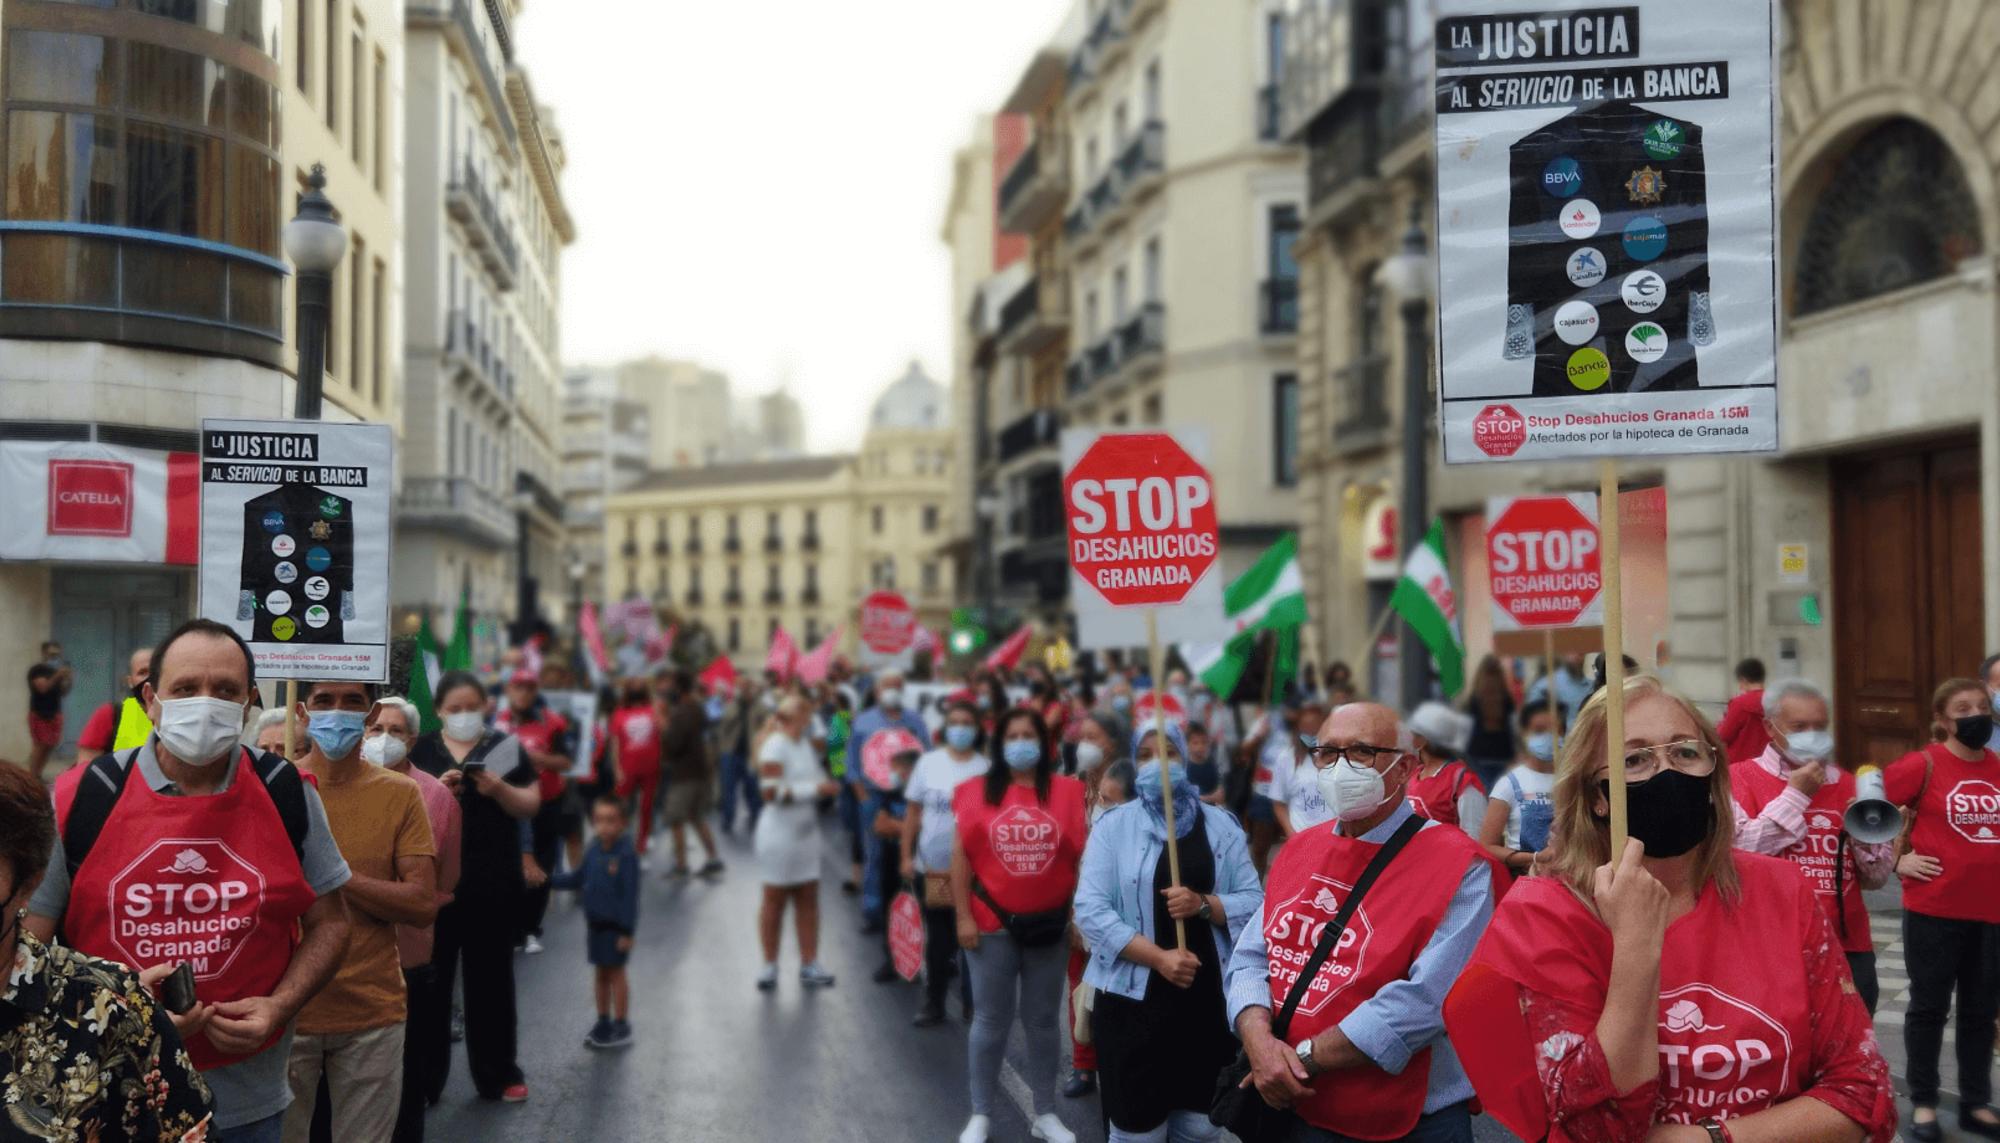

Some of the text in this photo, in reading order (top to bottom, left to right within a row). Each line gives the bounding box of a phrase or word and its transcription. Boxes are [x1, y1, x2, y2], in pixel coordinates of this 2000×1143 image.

[1451, 15, 1630, 61] LA JUSTICIA
[1451, 66, 1721, 108] AL SERVICIO DE LA BANCA
[1545, 171, 1582, 184] BBVA
[1476, 419, 1522, 435] STOP
[1527, 405, 1749, 429] Stop Desahucios Granada 15M
[1528, 424, 1749, 444] Afectados por la hipoteca de Granada
[212, 434, 313, 459] LA JUSTICIA
[211, 464, 363, 486] AL SERVICIO DE LA BANCA
[60, 491, 122, 505] CATELLA
[1070, 474, 1211, 535] STOP
[1074, 532, 1216, 564] DESAHUCIOS
[1492, 528, 1598, 574] STOP
[1096, 564, 1193, 590] GRANADA
[1493, 571, 1600, 595] DESAHUCIOS
[1510, 594, 1582, 613] GRANADA
[996, 822, 1053, 842] STOP
[995, 841, 1056, 852] Desahucios
[1003, 851, 1048, 863] Granada
[124, 879, 249, 918] STOP
[121, 914, 252, 937] Desahucios
[135, 934, 232, 958] Granada
[1658, 1038, 1772, 1089] TOP
